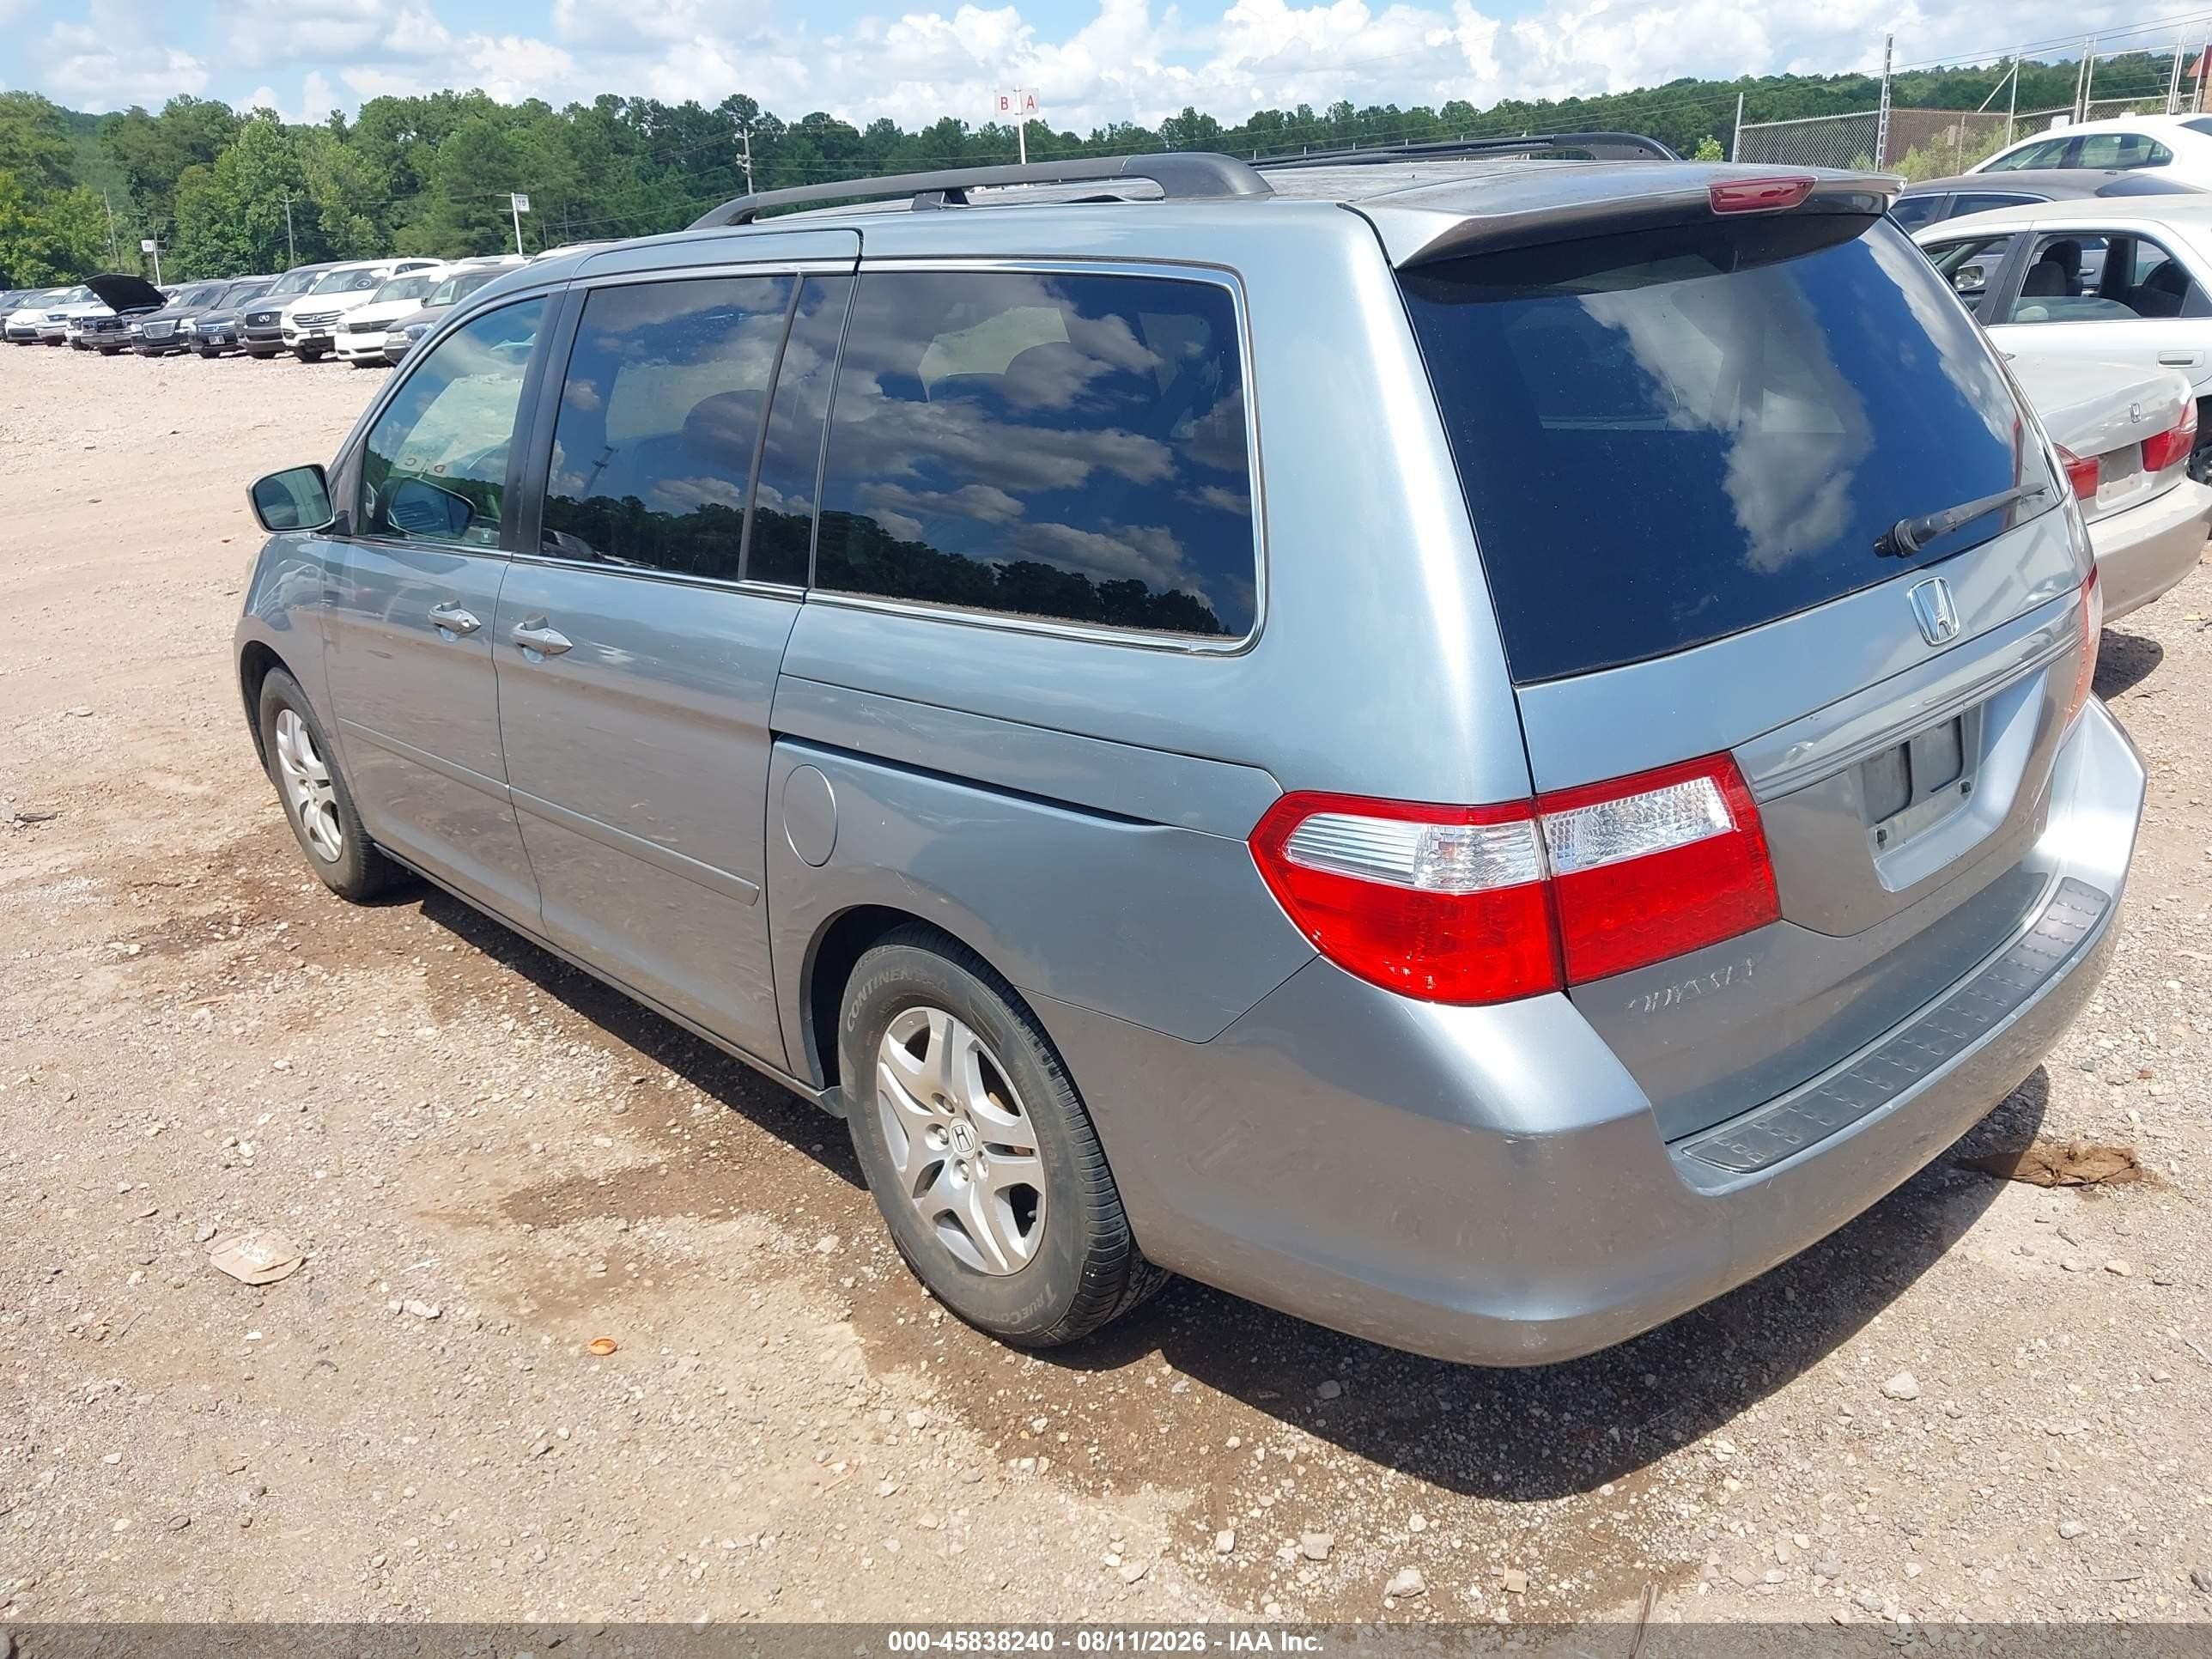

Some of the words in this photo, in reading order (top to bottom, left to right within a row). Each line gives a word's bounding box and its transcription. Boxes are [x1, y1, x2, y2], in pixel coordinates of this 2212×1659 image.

[1000, 96, 1009, 110] B
[1026, 94, 1036, 109] A
[846, 966, 946, 1032] CONTINEN
